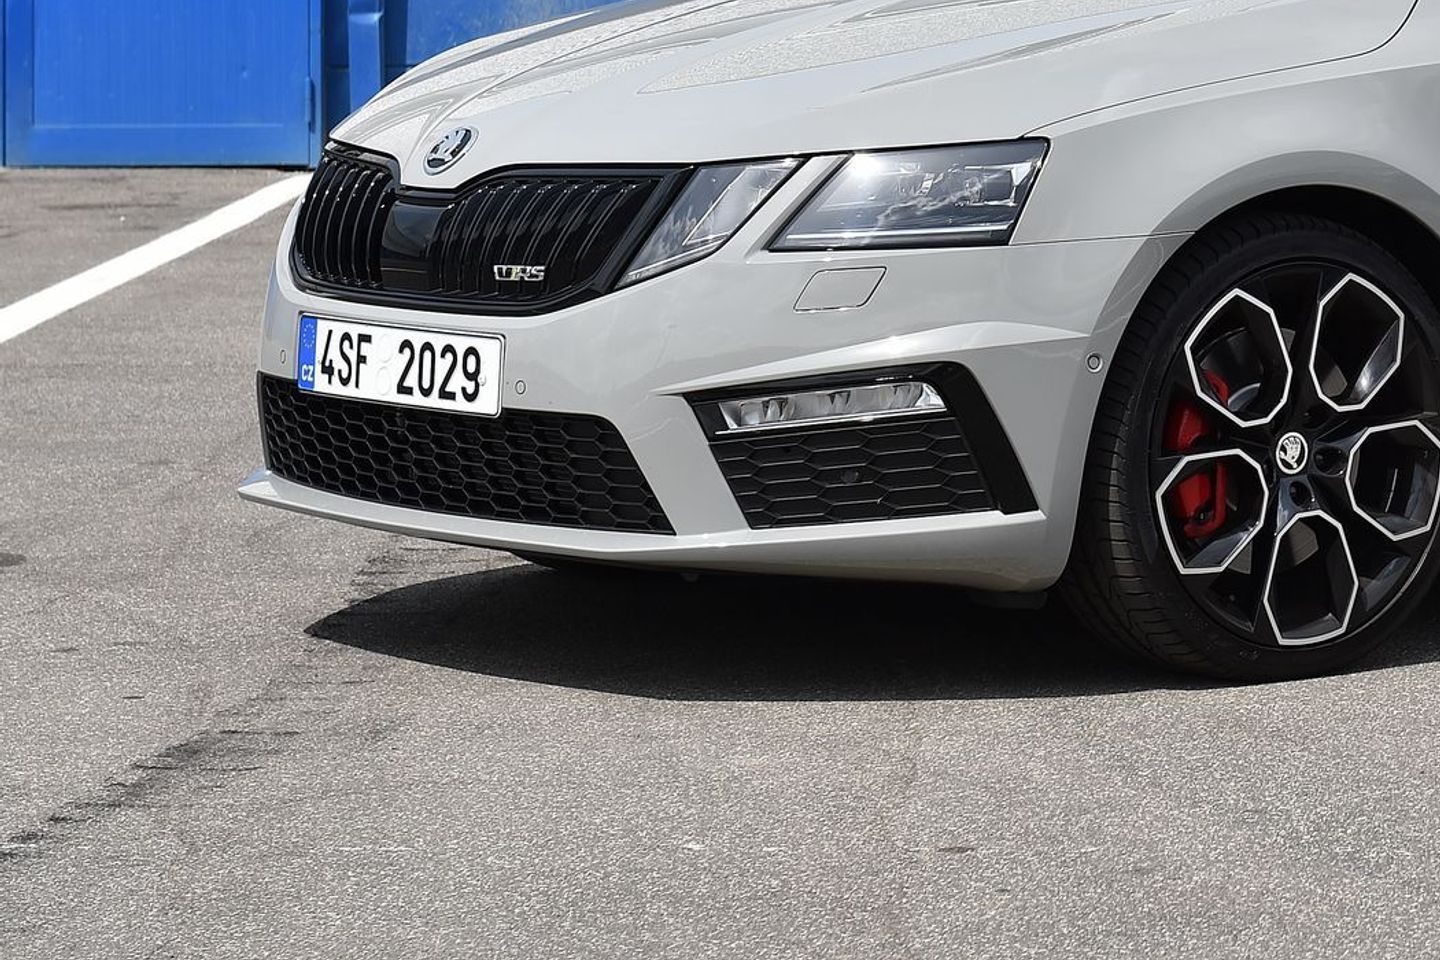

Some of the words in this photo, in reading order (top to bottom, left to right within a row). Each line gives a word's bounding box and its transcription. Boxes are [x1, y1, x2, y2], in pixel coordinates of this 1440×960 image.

[301, 364, 315, 382] CZ
[320, 329, 372, 389] 4SF
[396, 339, 481, 403] 2029
